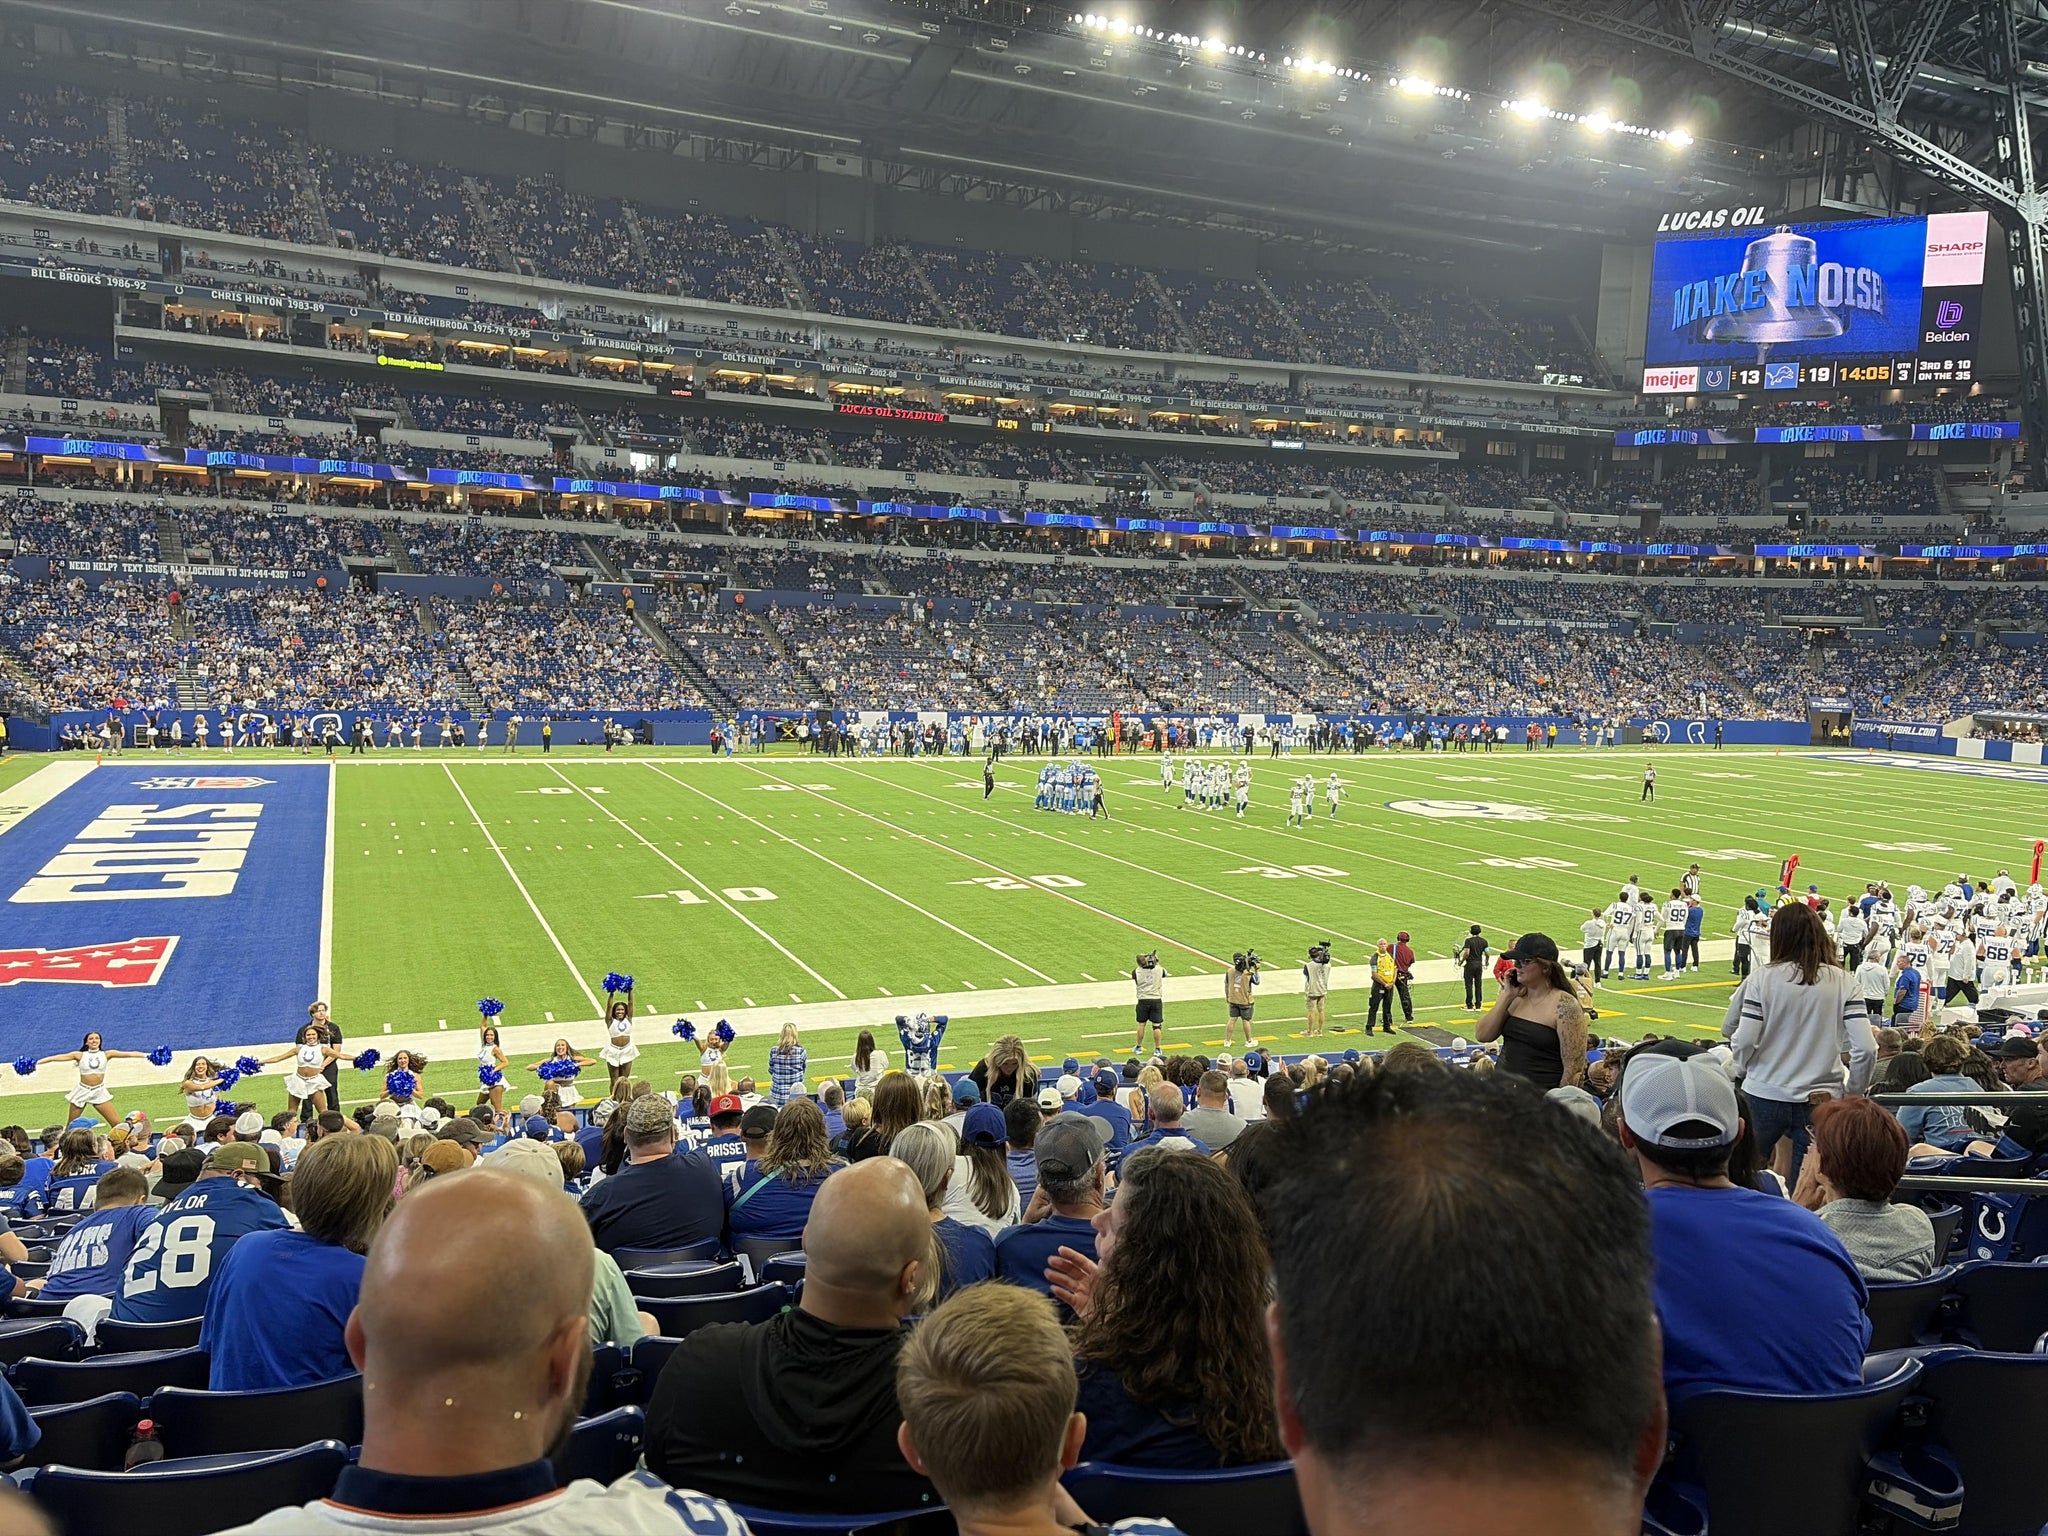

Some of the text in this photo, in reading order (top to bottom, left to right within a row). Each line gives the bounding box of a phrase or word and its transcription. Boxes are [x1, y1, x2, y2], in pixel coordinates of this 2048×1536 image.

[1657, 206, 1765, 232] LUCAS OIL
[35, 230, 48, 238] 508
[1928, 242, 1983, 253] SHARP
[31, 268, 147, 291] BILL BROOKS 1986-92
[211, 290, 325, 313] CHRIS HINTON 1983-89
[1671, 269, 1767, 331] MAKE
[383, 311, 402, 323] TED
[403, 315, 469, 332] MARCHIBRODA
[508, 327, 531, 338] 92-95
[1925, 331, 1970, 343] Belden
[581, 337, 675, 356] JIM HARBAUGH 1994-97
[387, 357, 444, 371] Huntington Bank
[722, 353, 776, 366] COLTS NATION
[1897, 362, 1911, 370] QTR
[1919, 360, 1971, 371] 3RD & 10
[821, 364, 841, 373] TONY
[843, 365, 866, 375] DUNGY
[1809, 367, 1830, 382] 19
[1839, 366, 1890, 381] 14:05
[1898, 370, 1908, 381] 3
[1918, 371, 1971, 381] ON THE 35
[939, 376, 966, 387] MARVIN
[968, 378, 1002, 389] HARRISON
[1646, 371, 1695, 389] meijer
[1740, 370, 1760, 385] 13
[671, 389, 693, 397] verizon
[1069, 389, 1101, 400] EDGERRIN
[1103, 392, 1124, 401] JAMES
[1190, 400, 1205, 408] ERIC
[1207, 401, 1243, 410] DICKERSON
[840, 404, 945, 422] LUCAS OIL STADIUM
[1305, 408, 1338, 417] MARSHALL
[1339, 410, 1358, 419] FAULK
[269, 419, 283, 427] 309
[1031, 422, 1044, 433] QTR
[18, 489, 34, 497] 208
[273, 505, 287, 513] 209
[69, 561, 91, 571] NEED
[93, 562, 118, 572] HELP?
[122, 563, 143, 573] TEXT
[145, 564, 168, 574] ISSUE
[188, 566, 225, 576] LOCATION
[227, 568, 238, 577] TO
[239, 568, 289, 579] 317-644-4357
[8, 803, 265, 904] COLTS
[1613, 910, 1632, 925] 97
[1670, 908, 1687, 922] 99
[1906, 952, 1927, 967] 79
[1986, 946, 2008, 961] 68
[707, 1141, 747, 1157] BRISSET
[123, 1215, 216, 1299] 28
